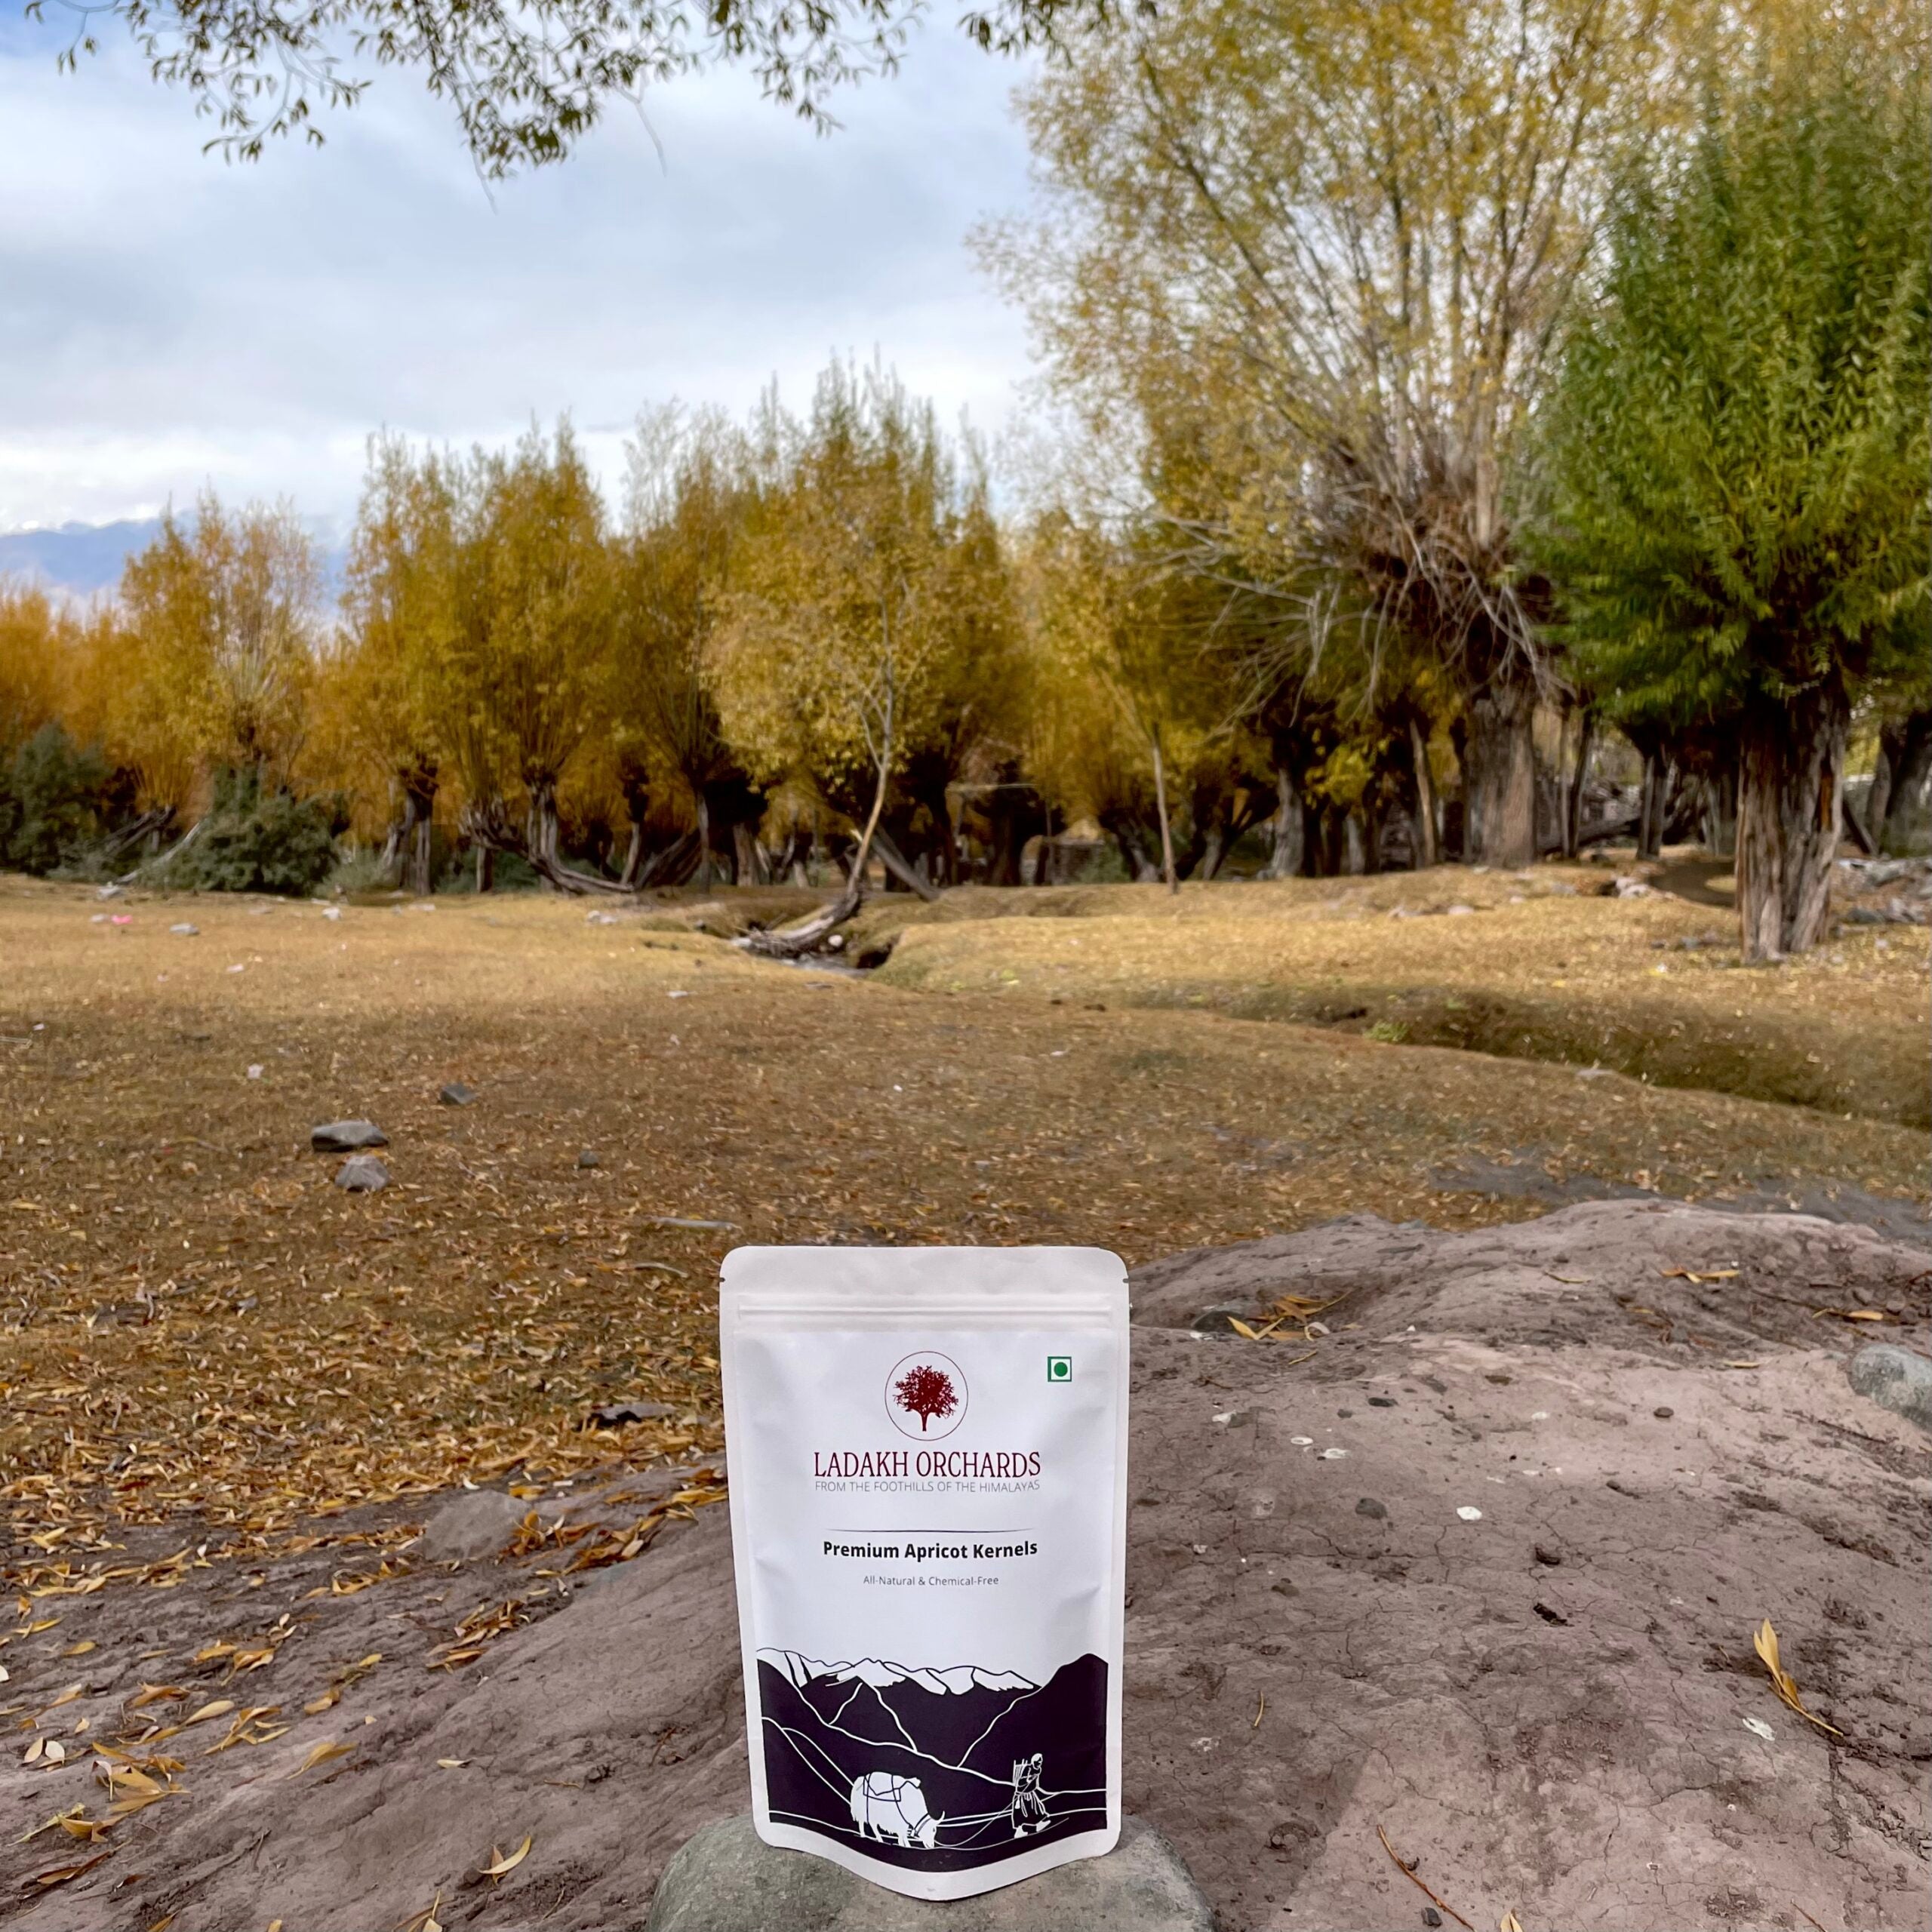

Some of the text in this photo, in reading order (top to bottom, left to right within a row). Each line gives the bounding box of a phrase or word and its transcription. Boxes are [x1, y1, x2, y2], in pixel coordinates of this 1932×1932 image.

[814, 1451, 1041, 1478] LADAKH ORCHARDS
[815, 1479, 1041, 1493] FROM THE FOOTHILLS OF THE HIMALAYAS
[823, 1540, 1038, 1562] Premium Apricot Kernels
[863, 1576, 998, 1586] All-Natural & Chemical-Free
